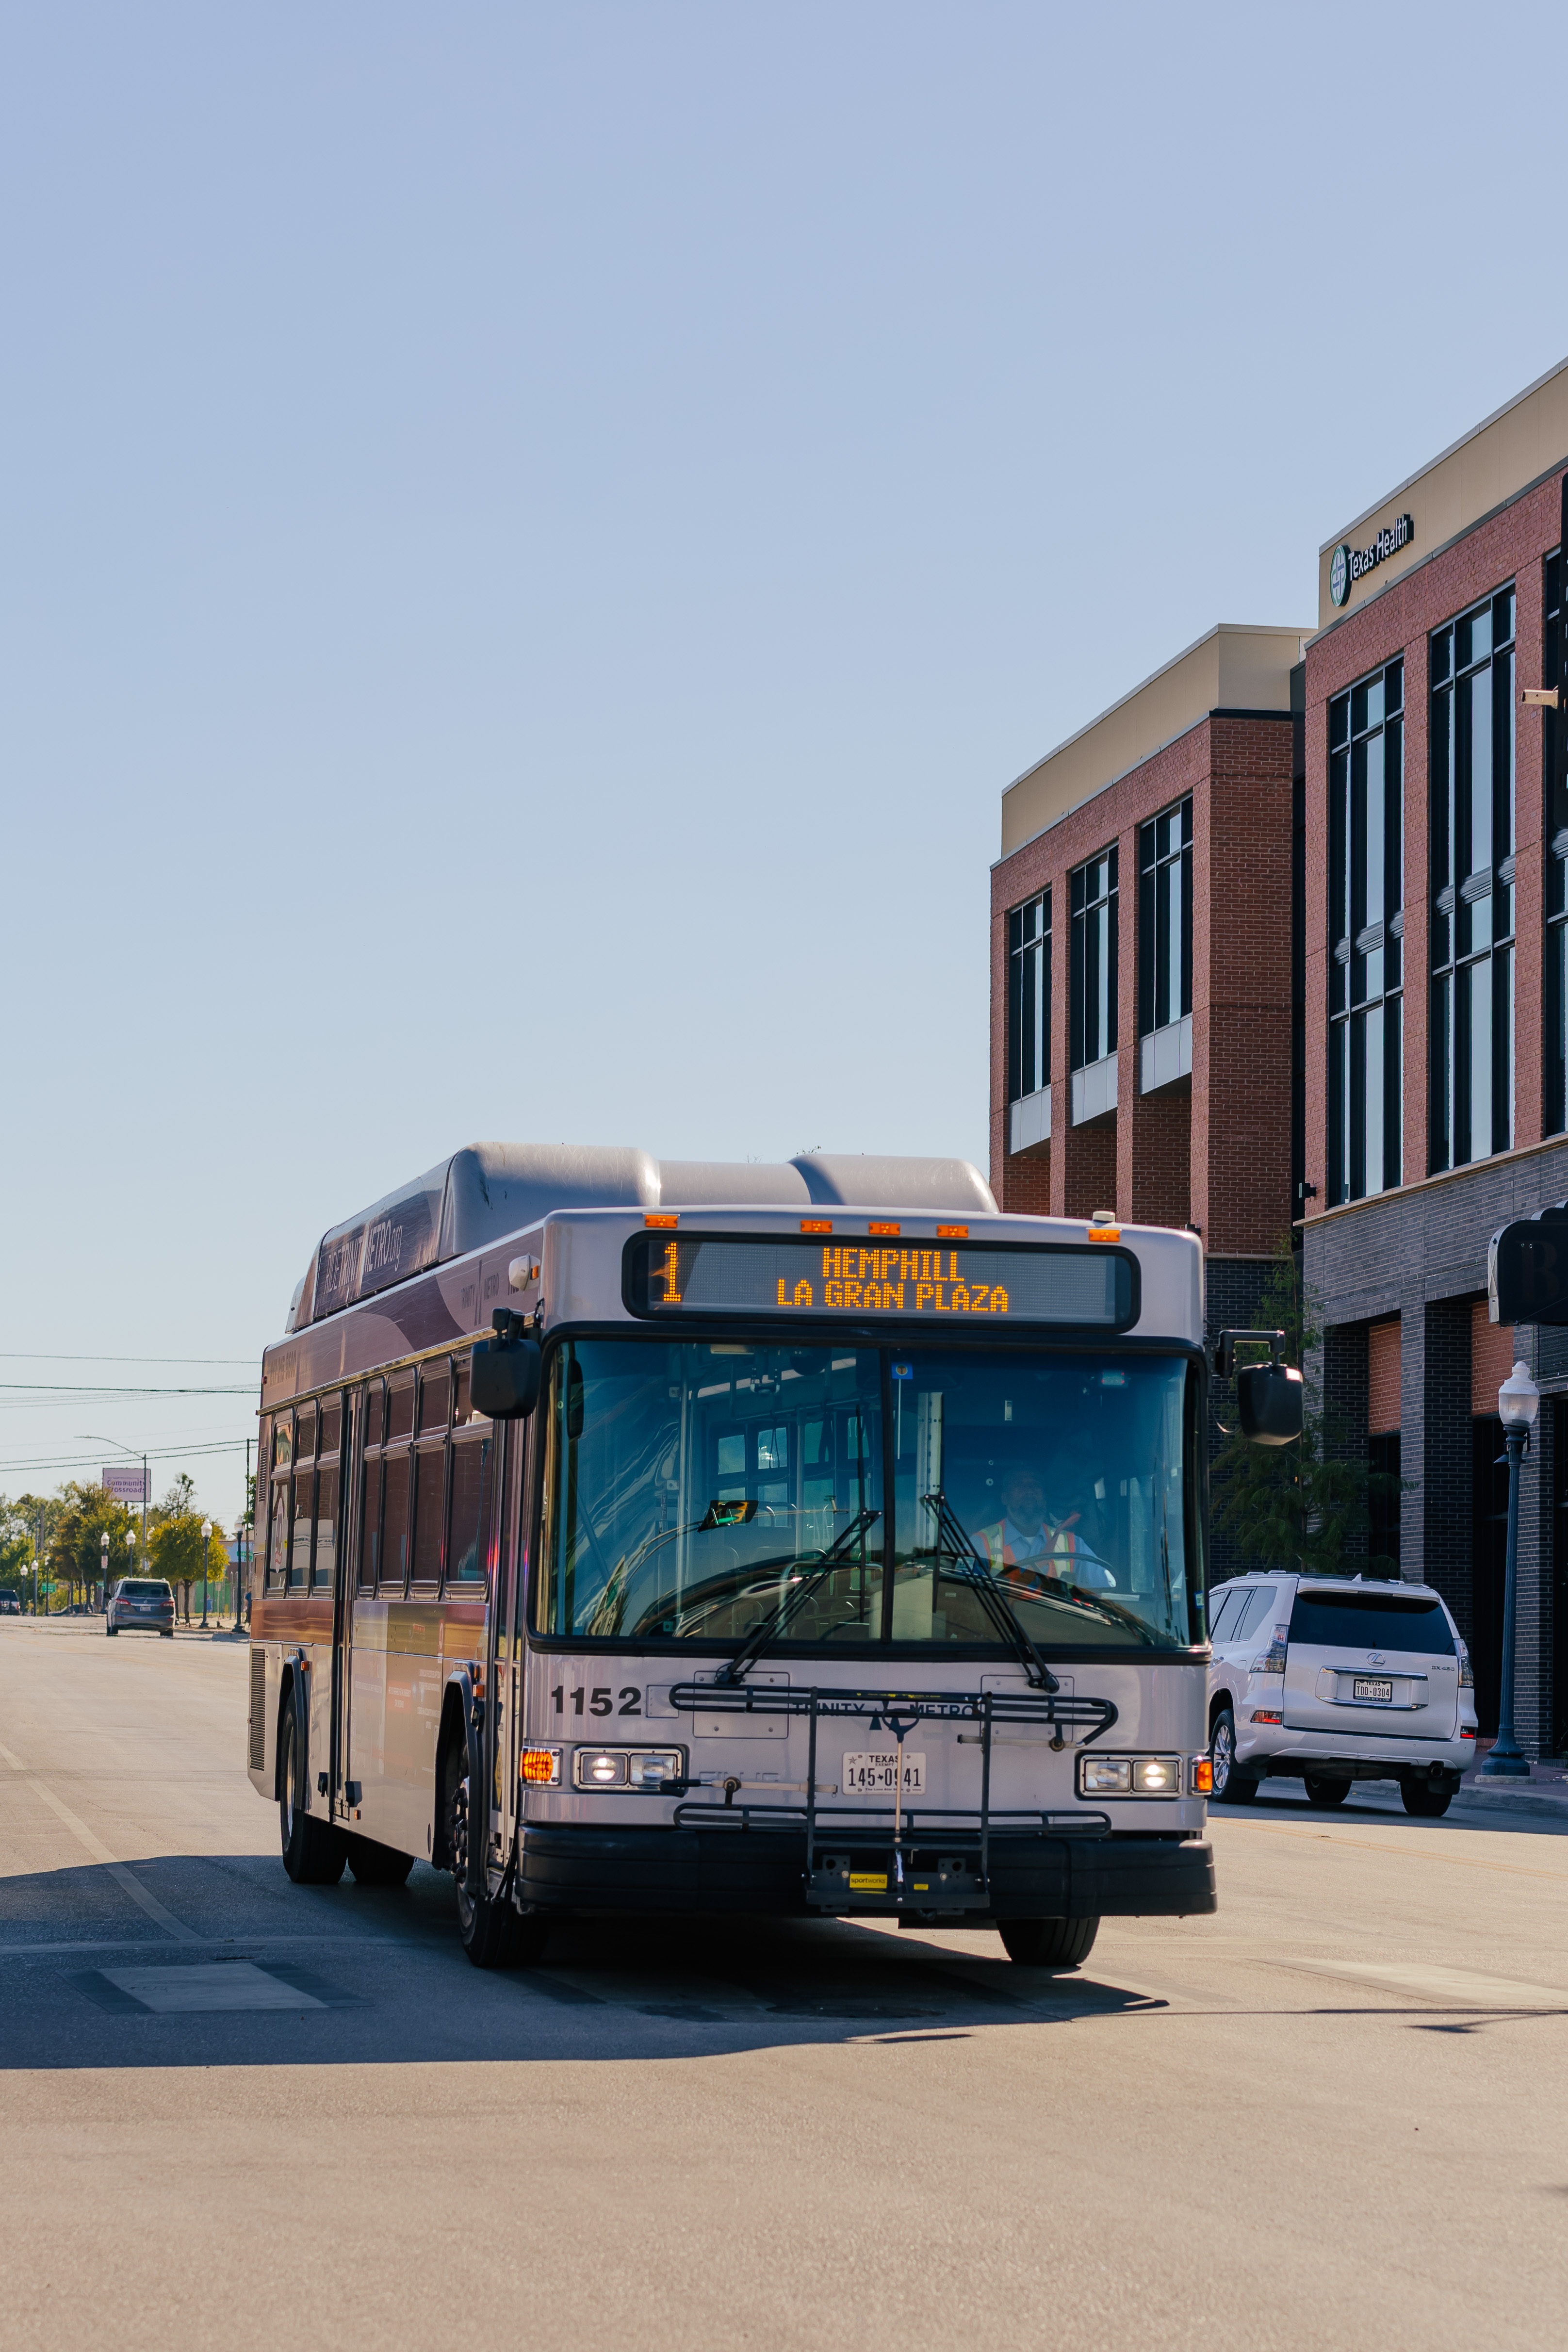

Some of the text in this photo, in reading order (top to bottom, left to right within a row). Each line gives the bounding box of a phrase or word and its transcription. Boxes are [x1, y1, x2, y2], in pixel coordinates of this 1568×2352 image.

[1348, 514, 1408, 581] Texas Health
[324, 1219, 403, 1294] RIDETRINITMETRO.org
[664, 1242, 681, 1301] 1
[823, 1247, 964, 1281] HEMPHILL
[777, 1279, 1008, 1312] LA GRAN PLAZA
[551, 1685, 641, 1716] 1152
